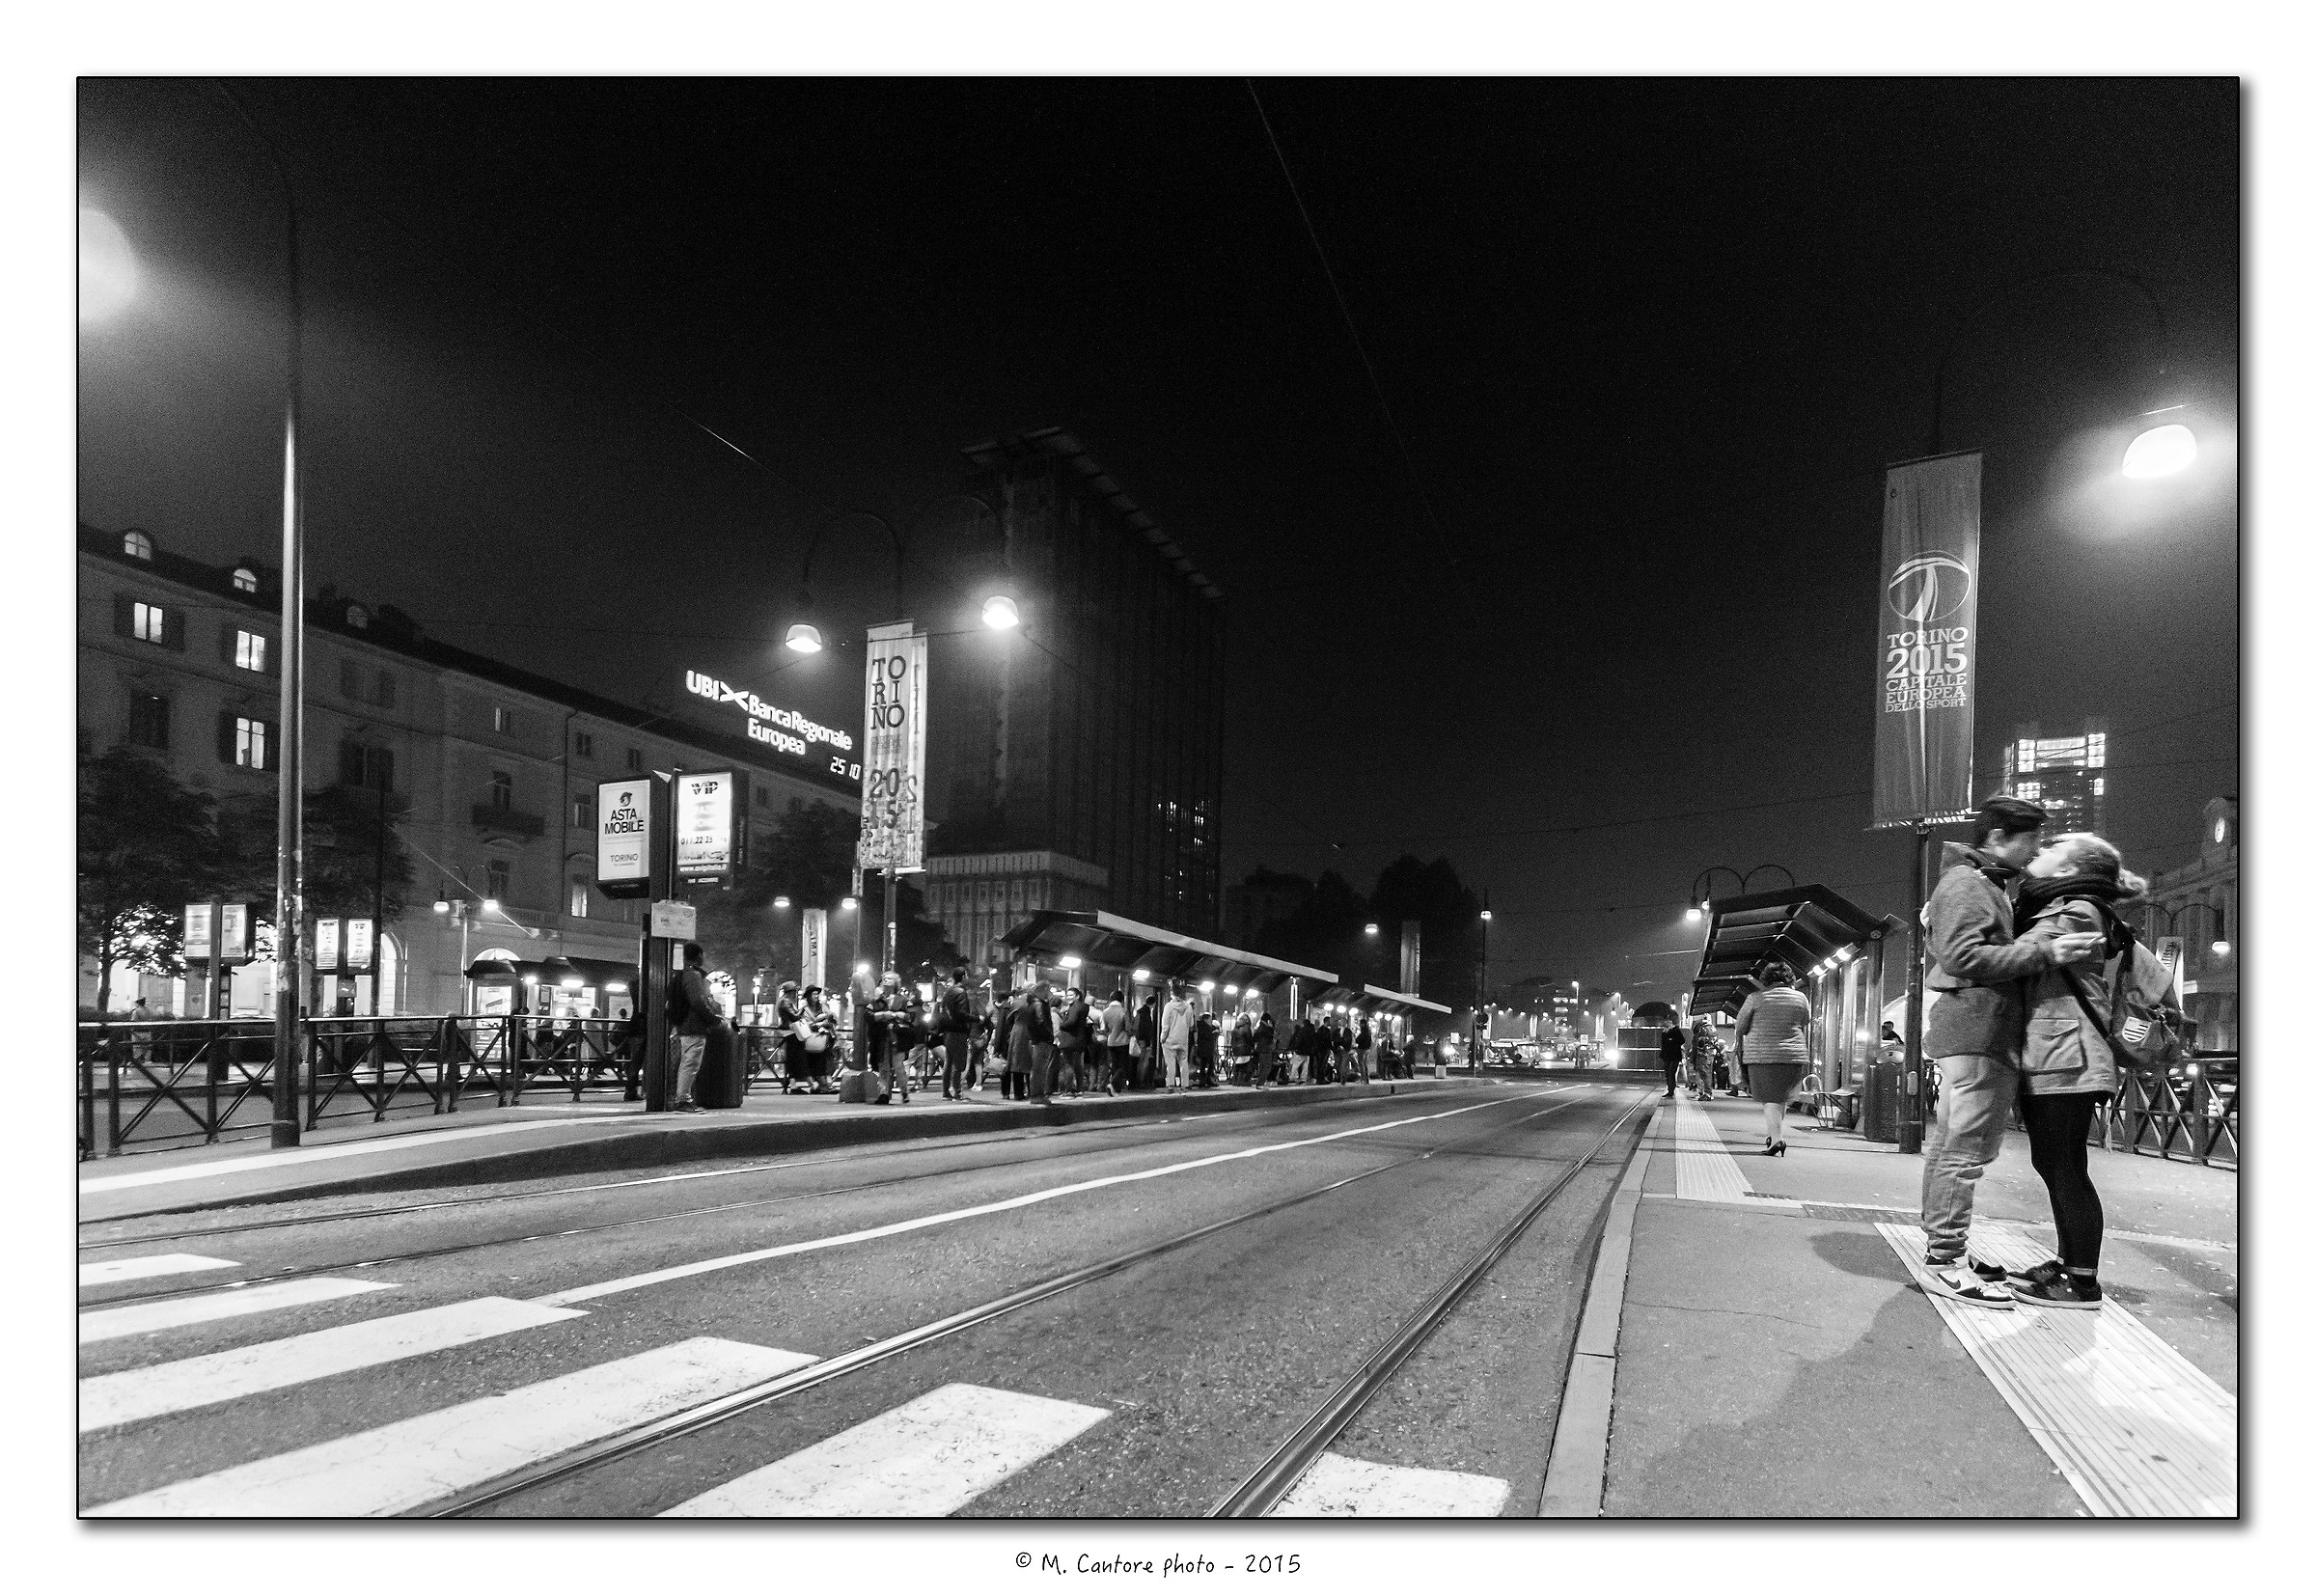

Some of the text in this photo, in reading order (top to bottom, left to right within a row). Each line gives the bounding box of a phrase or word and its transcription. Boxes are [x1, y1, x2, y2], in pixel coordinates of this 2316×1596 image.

[1887, 626, 1969, 648] TORINO
[1887, 643, 1968, 679] 2015
[686, 671, 720, 701] UBI
[1886, 673, 1967, 692] CAPTALE
[1886, 686, 1967, 704] EUROPEA
[1885, 698, 1967, 713] DELLO SPORT
[748, 717, 806, 756] Europea
[830, 757, 862, 780] 25 10
[611, 808, 638, 822] ASTA
[604, 819, 644, 835] MOBILE
[610, 853, 638, 863] TORINO
